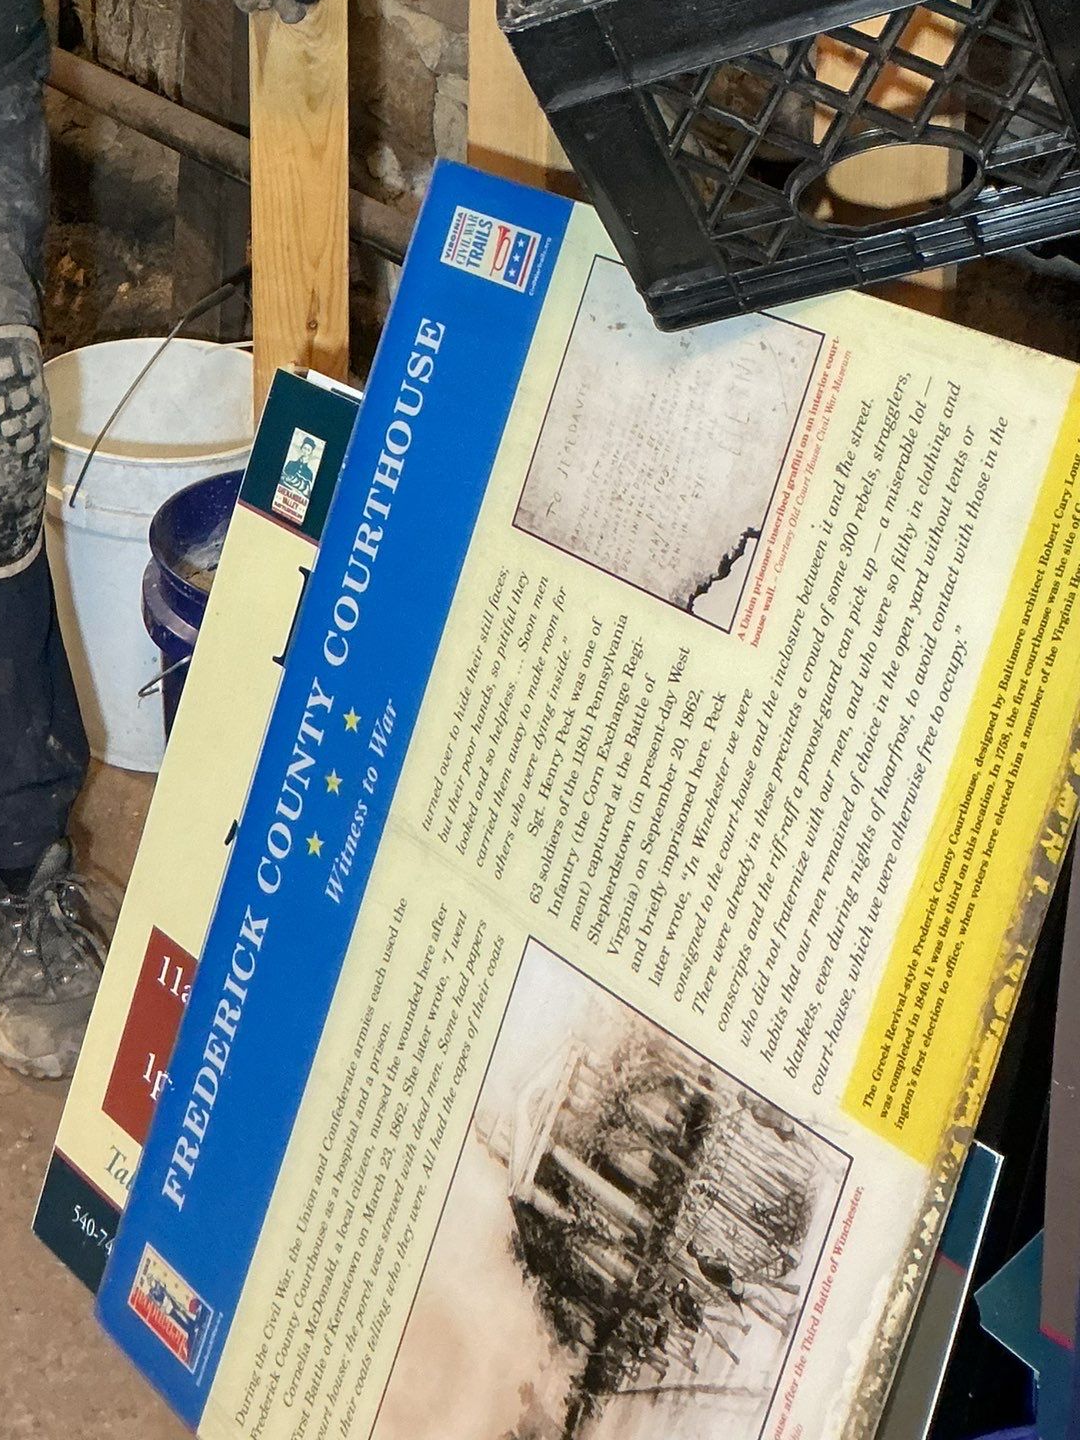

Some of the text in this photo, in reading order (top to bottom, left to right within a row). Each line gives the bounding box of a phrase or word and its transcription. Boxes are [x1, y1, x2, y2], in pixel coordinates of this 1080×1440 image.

[443, 211, 464, 259] VIRGINIA
[464, 217, 493, 268] TRAILS
[738, 595, 757, 630] Union
[752, 545, 772, 596] prisoner
[766, 489, 791, 545] inscribed
[785, 448, 804, 491] graffiti
[807, 370, 829, 416] interior
[824, 334, 840, 370] court-
[160, 903, 269, 1212] FREDERICK
[256, 675, 335, 894] COUNTY
[322, 316, 446, 666] COURTHOUSE
[323, 697, 397, 904] Witness to War
[526, 614, 603, 837] Sgt. Henry Peck was one of
[528, 613, 628, 904] 63 soldiers of the 118th Pennsylvania
[546, 635, 644, 919] Infantry (the Corn Exchange Regi-
[569, 671, 656, 932] ment) captured at the Battle of
[586, 646, 690, 946] Shepherdstown (in present-day West
[605, 688, 705, 955] Virginia) on September 20, 1862,
[630, 690, 727, 973] and briefly imprisoned here. Peck
[647, 687, 753, 987] later wrote, “In Winchester we were
[690, 372, 912, 1016] There were already in these precincts a crowd of some 300 rebels, stragglers,
[861, 487, 1072, 1108] The Greek Revival-style Frederick County Courthouse, designed by Baltimore architect Robert Cary
[810, 624, 968, 1096] court-house, which we were otherwise free to occupy.”
[233, 896, 408, 1428] During the Civil War, the Union and Confederate armies each used the
[282, 901, 448, 1408] Cornelia McDonald, a local citizen, nursed the wounded here after
